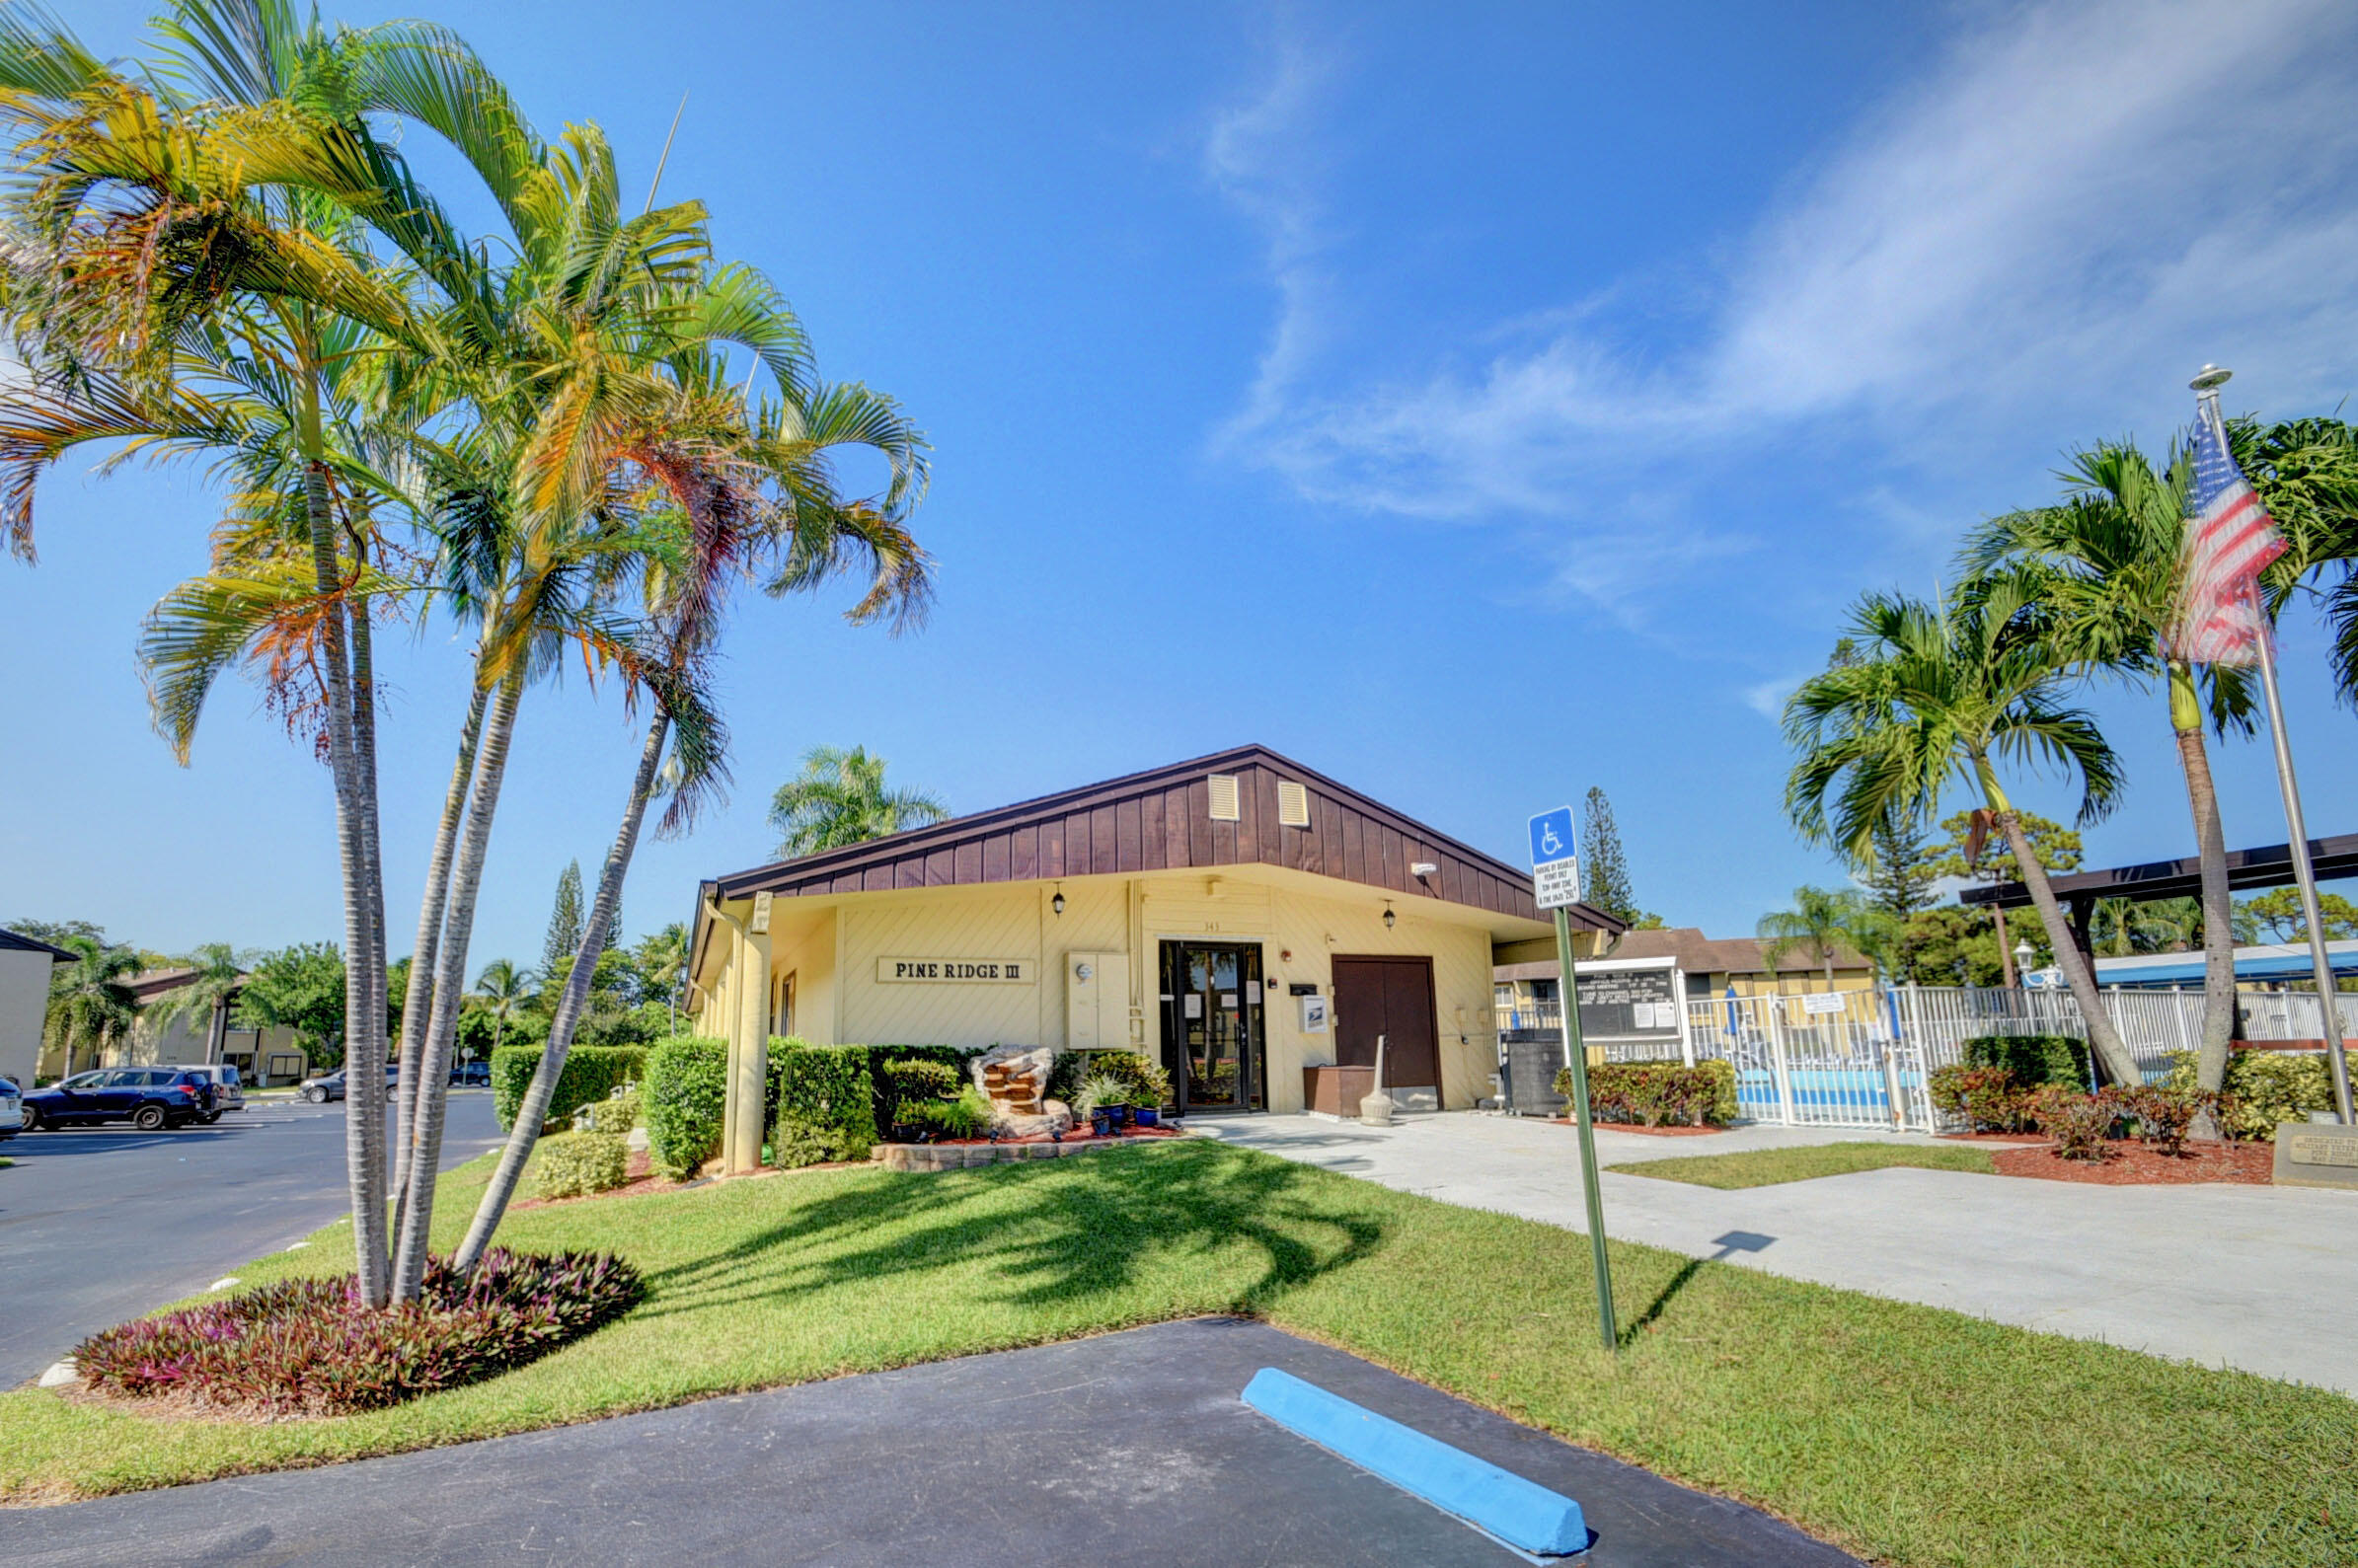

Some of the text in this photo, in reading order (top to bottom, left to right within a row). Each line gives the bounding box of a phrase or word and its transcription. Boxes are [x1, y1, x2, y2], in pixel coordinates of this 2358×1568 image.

[896, 963, 1020, 979] PINE RIDGE III
